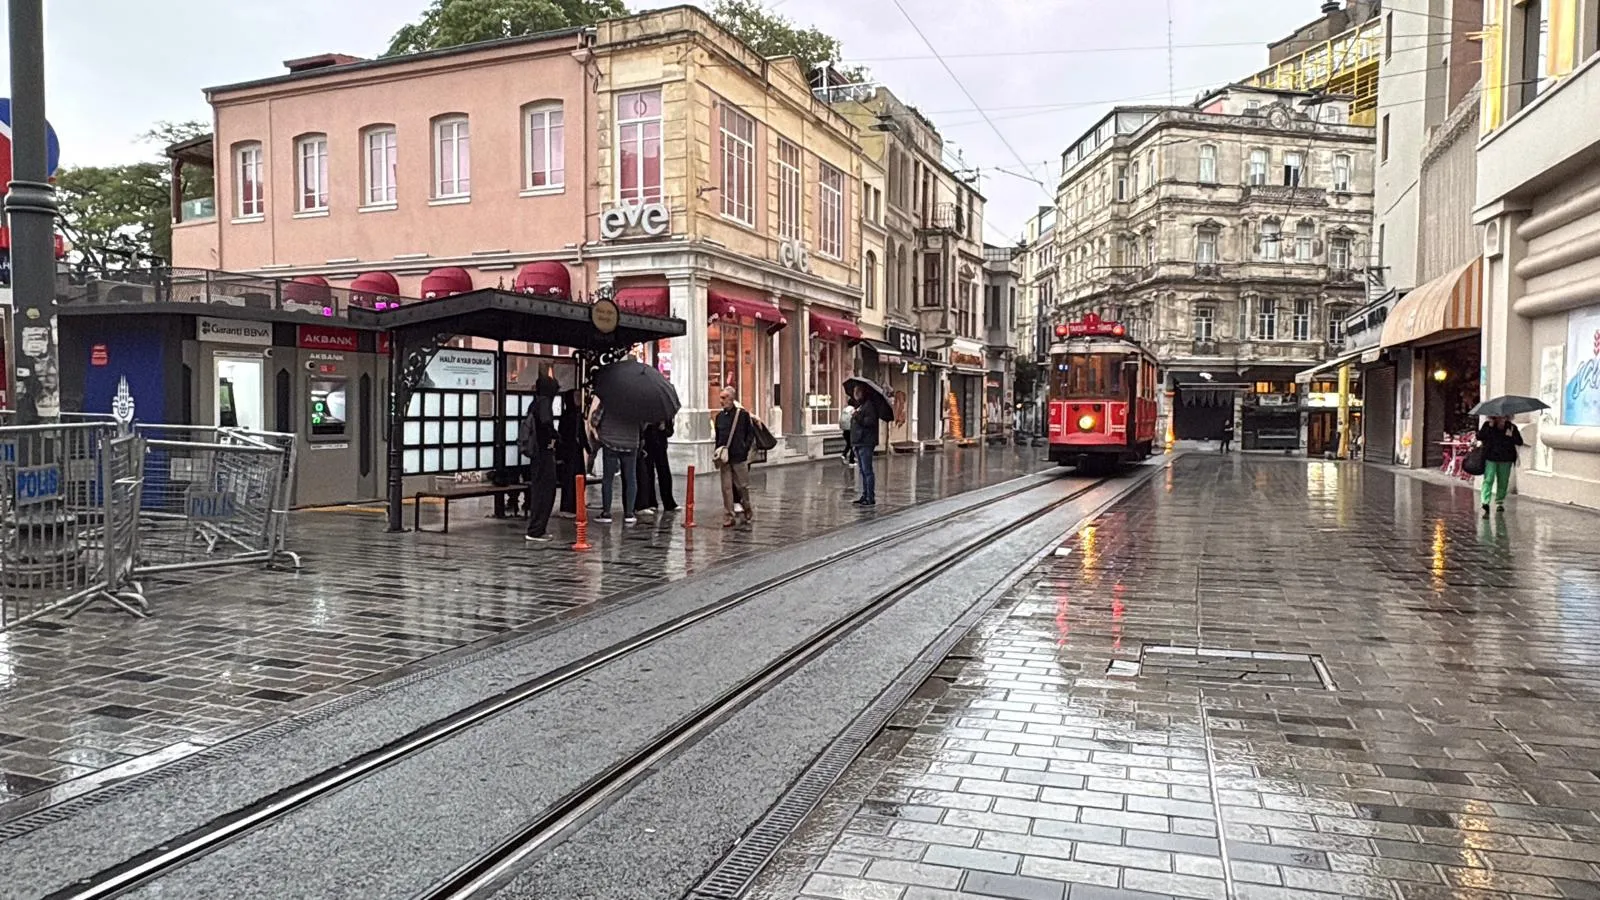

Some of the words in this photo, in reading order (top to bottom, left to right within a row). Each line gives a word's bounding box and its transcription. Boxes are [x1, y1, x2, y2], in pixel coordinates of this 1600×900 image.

[602, 198, 669, 239] eve
[210, 323, 243, 336] Garanti
[243, 327, 270, 338] BBVA
[304, 333, 353, 346] AKBANK
[900, 332, 918, 353] ESQ
[308, 352, 344, 361] AKBANK
